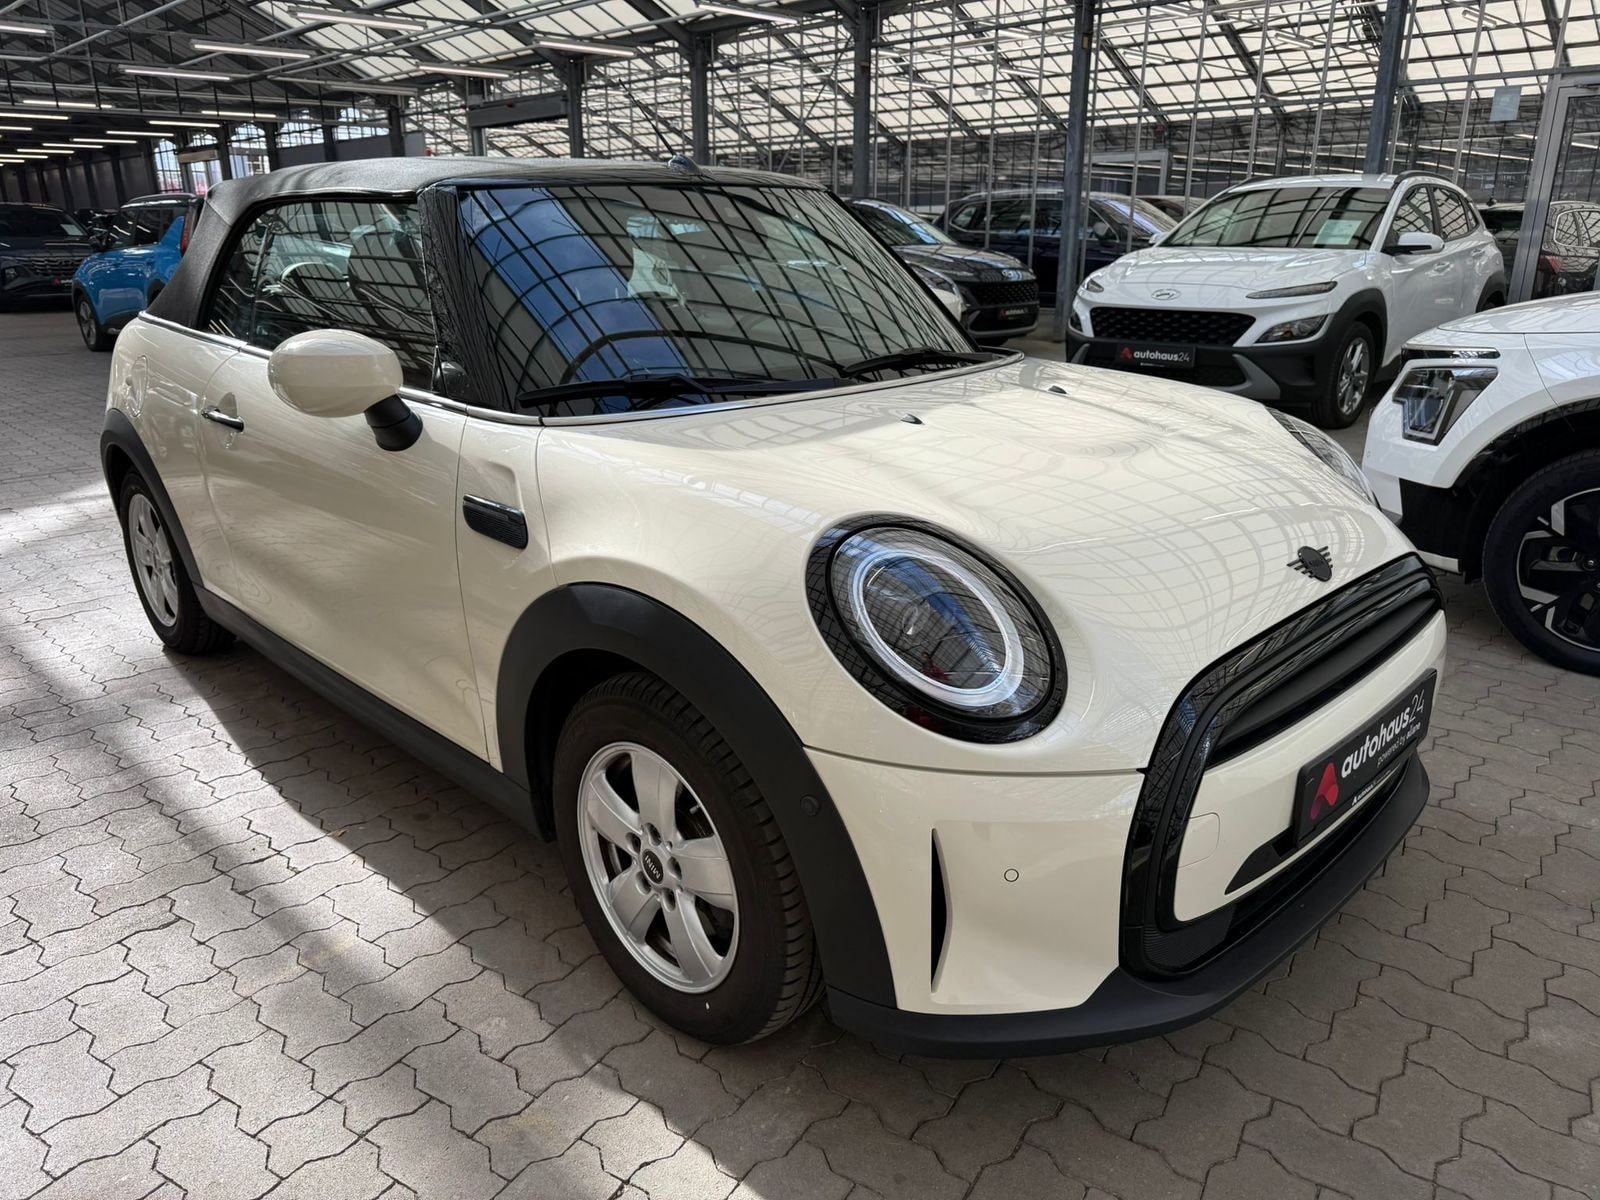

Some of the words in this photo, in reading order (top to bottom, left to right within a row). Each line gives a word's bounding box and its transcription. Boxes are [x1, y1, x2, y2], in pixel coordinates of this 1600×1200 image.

[1133, 350, 1190, 362] autohaus24
[1341, 689, 1425, 779] autohaus24
[1376, 737, 1399, 768] powered
[644, 855, 661, 879] MINI
